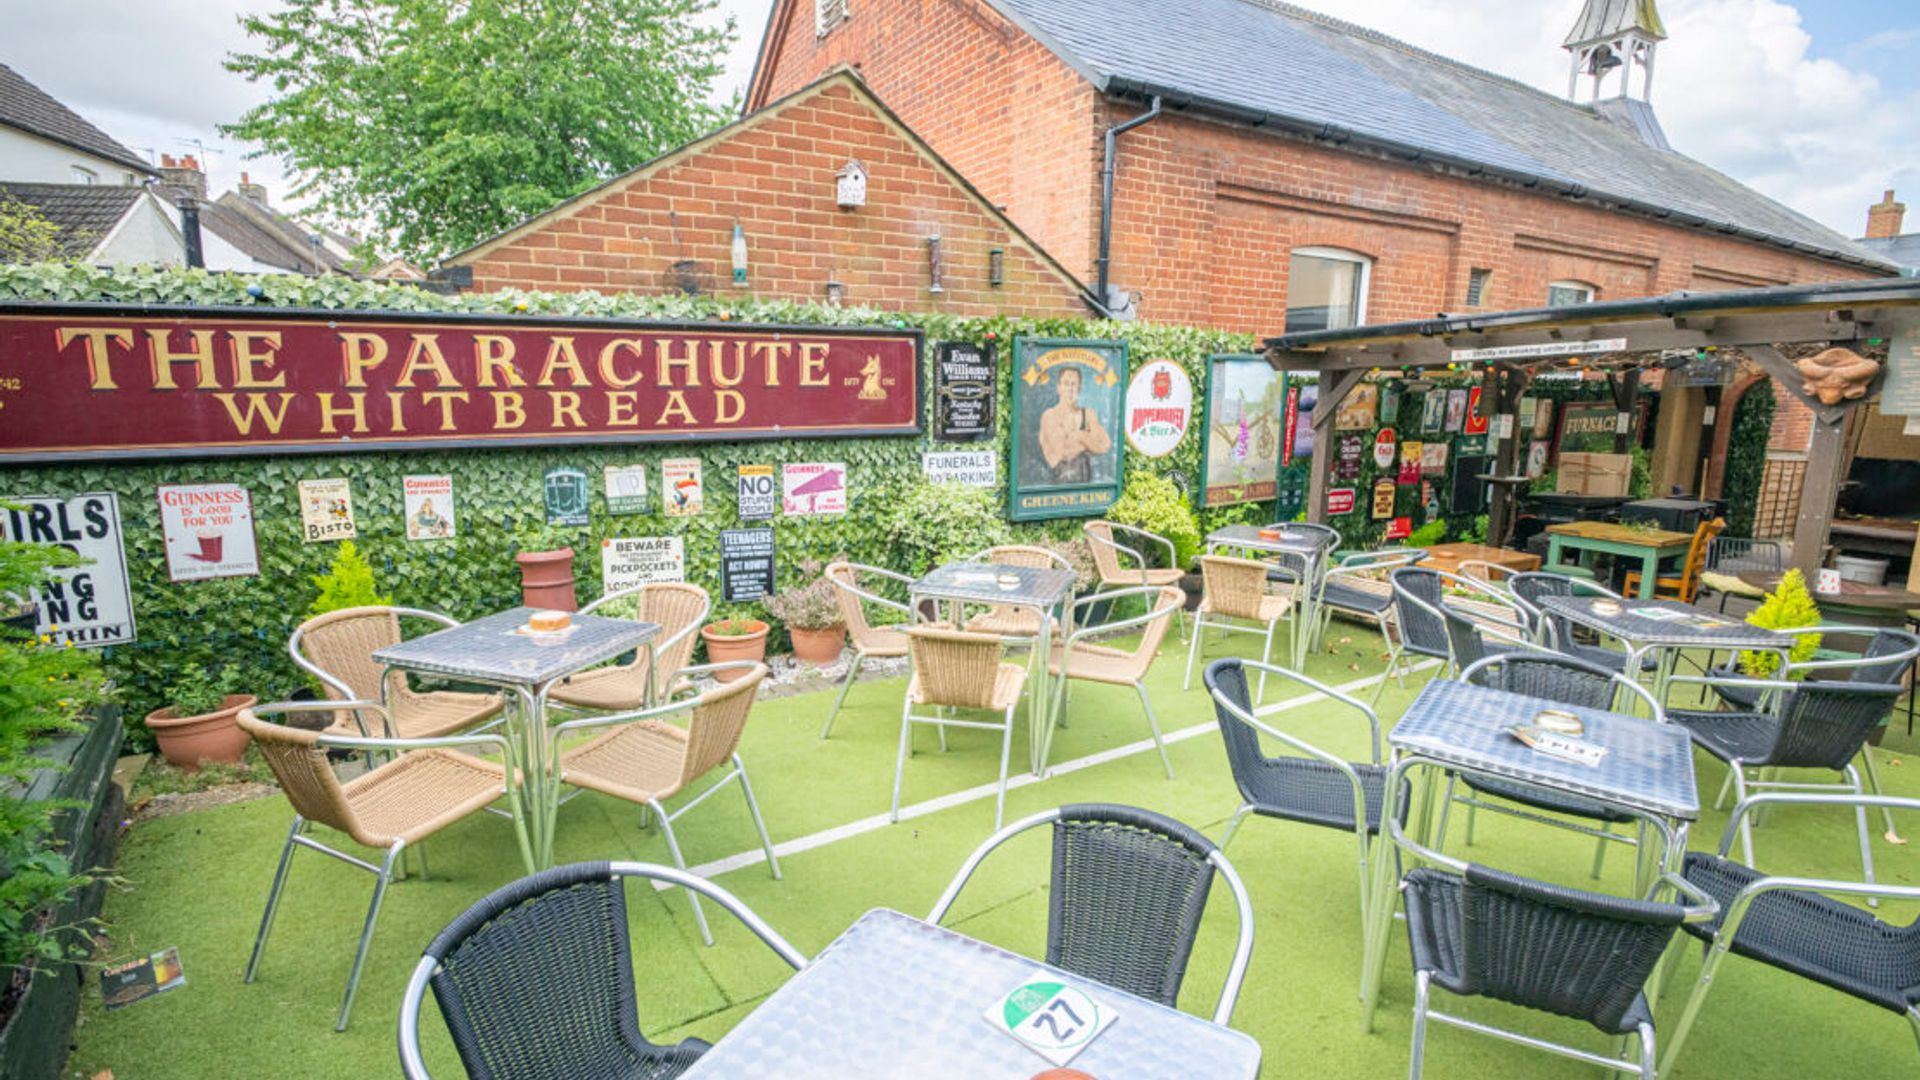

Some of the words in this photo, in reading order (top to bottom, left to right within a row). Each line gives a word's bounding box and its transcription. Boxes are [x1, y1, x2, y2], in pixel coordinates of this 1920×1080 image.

[57, 328, 286, 390] THE
[338, 333, 830, 389] PARACHUTE
[951, 350, 981, 363] Evan
[942, 363, 989, 375] Williams
[213, 390, 746, 434] WHITBREAD
[929, 456, 990, 468] FUNERALS
[786, 466, 824, 474] GUINNESS
[406, 480, 450, 488] GUINNESS
[741, 476, 772, 495] NO
[164, 490, 244, 506] GUINNESS
[741, 496, 772, 505] STUPID
[1022, 494, 1075, 508] GREENE
[1080, 491, 1112, 504] KING
[181, 508, 193, 516] IS
[200, 506, 232, 514] GOOD
[741, 504, 772, 514] PEOPLE
[0, 499, 109, 543] IRLS
[183, 517, 207, 528] FOR
[210, 516, 233, 526] YOU
[308, 522, 353, 539] BISTO
[723, 531, 772, 546] TEENAGERS
[616, 540, 672, 552] BEWARE
[611, 561, 678, 574] PICKPOCKETS
[42, 573, 95, 600] NG
[48, 625, 122, 644] THIN
[1032, 998, 1085, 1043] 27
